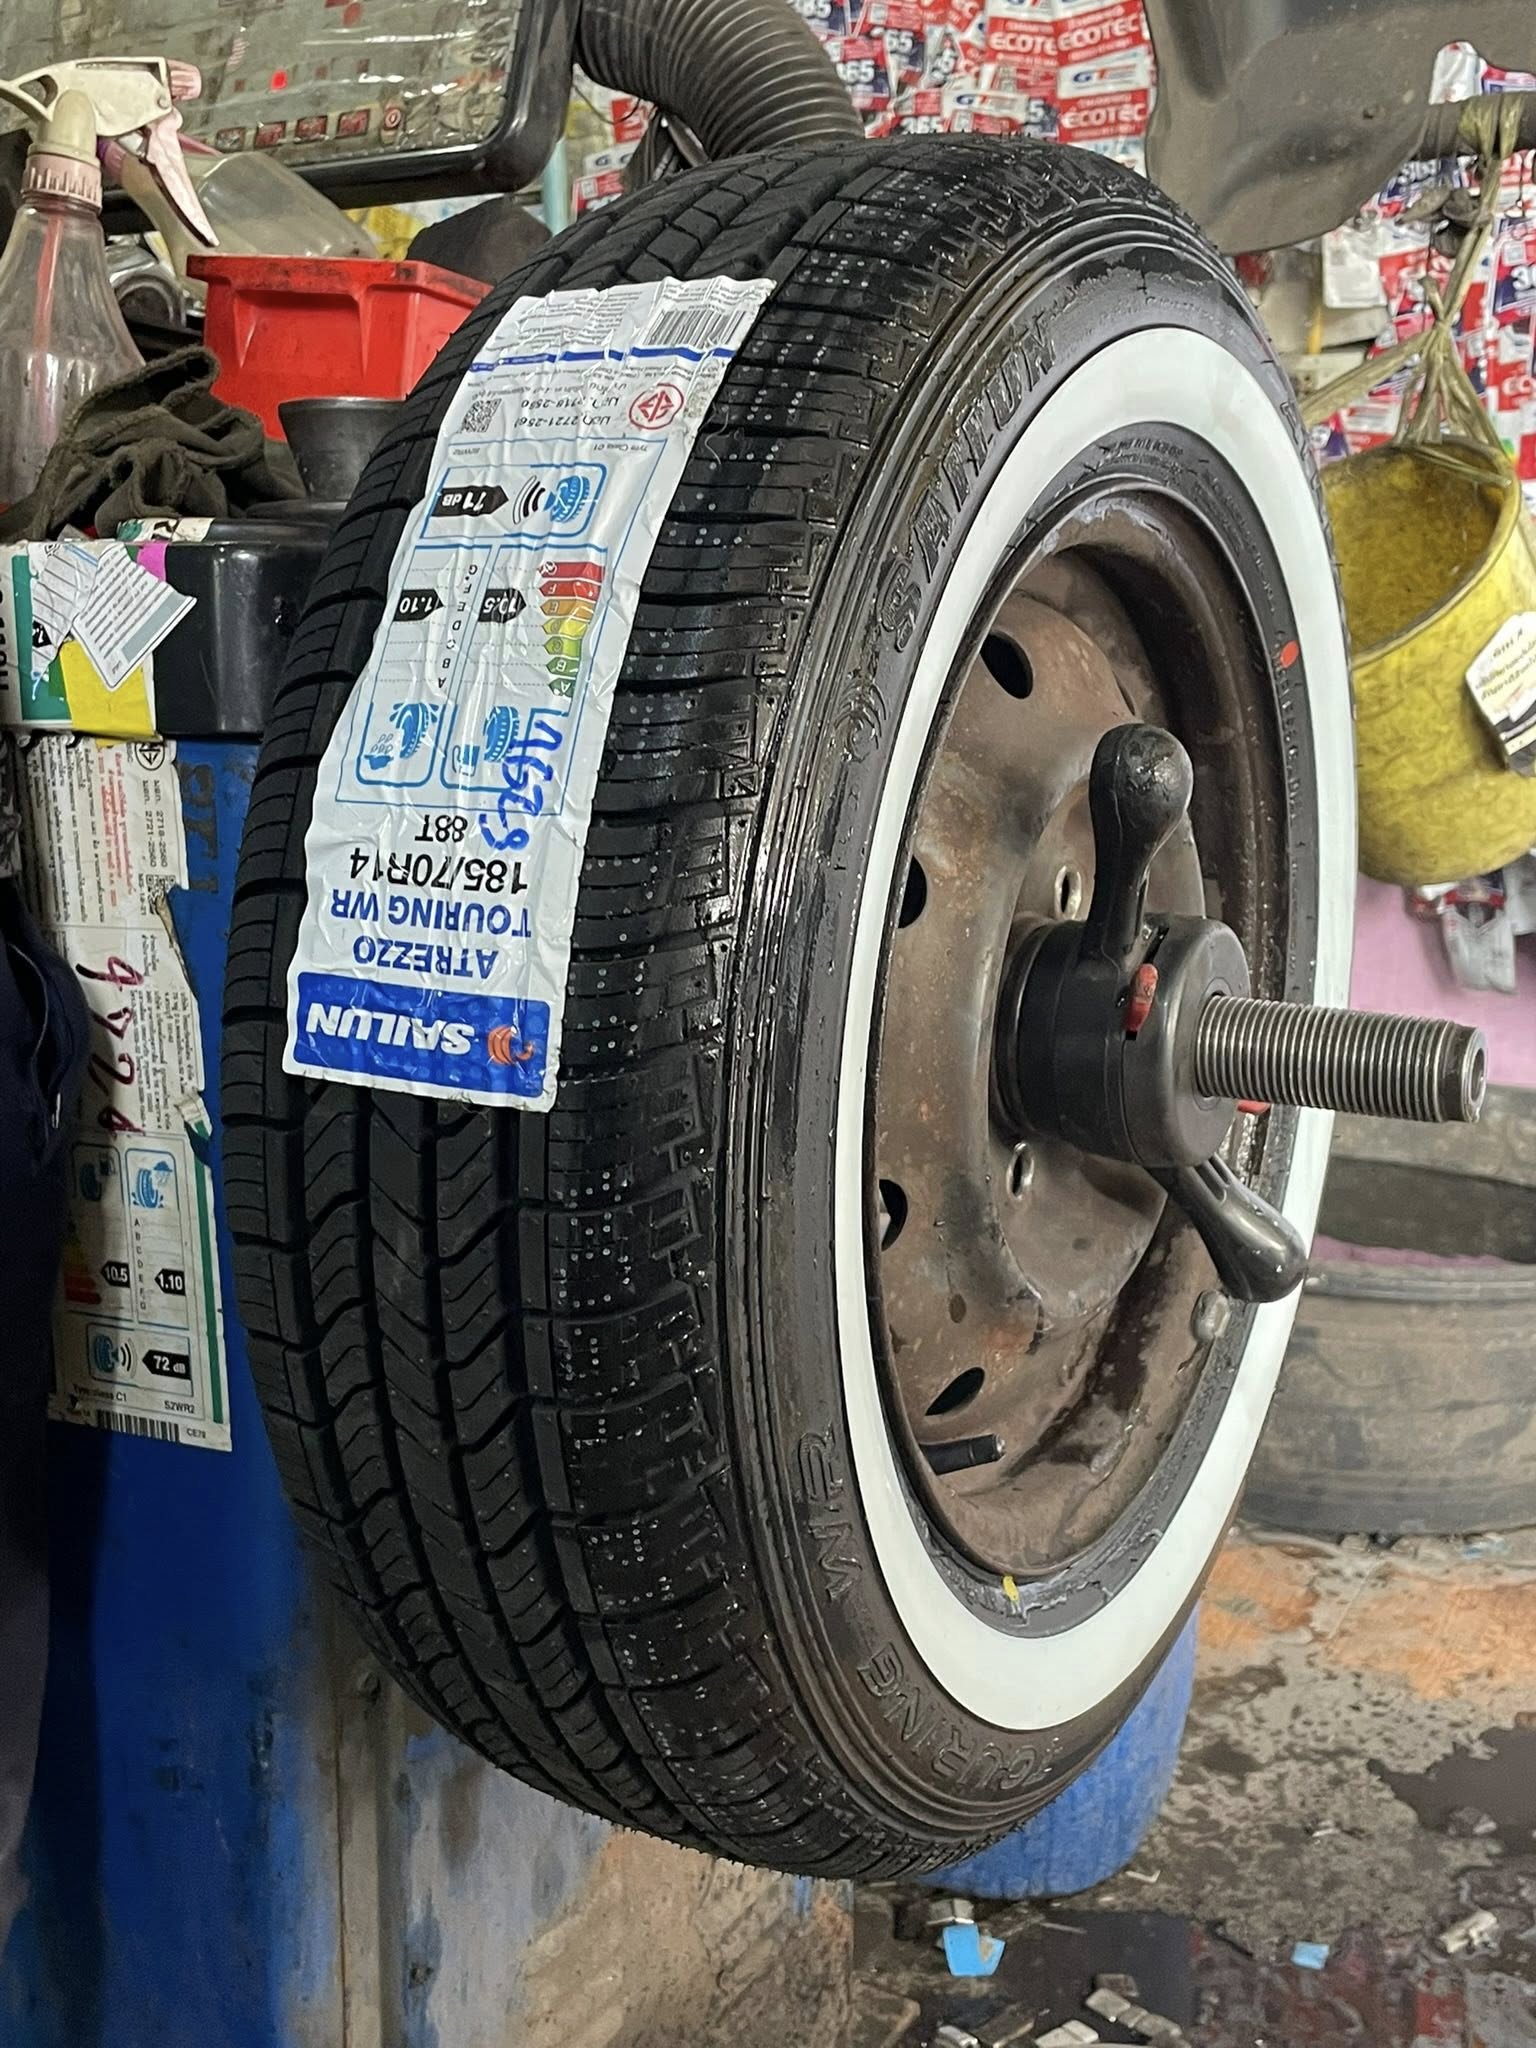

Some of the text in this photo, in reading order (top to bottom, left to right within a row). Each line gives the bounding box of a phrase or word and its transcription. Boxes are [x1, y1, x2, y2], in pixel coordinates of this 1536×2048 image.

[988, 31, 1058, 56] ECOTE
[877, 314, 1056, 653] SAILUN
[442, 492, 462, 506] dB
[463, 583, 472, 594] F
[399, 597, 434, 614] 1.10
[457, 601, 466, 612] E
[452, 620, 462, 631] D
[442, 657, 452, 669] B
[437, 676, 447, 688] A
[415, 813, 469, 842] 88T
[350, 847, 529, 894] 185/70R14
[331, 888, 531, 937] TOURING WR
[353, 935, 498, 980] ATREZZO
[305, 1002, 475, 1055] SAILUN
[104, 1265, 128, 1283] 10.5
[158, 1273, 183, 1291] 1.10
[153, 1355, 186, 1374] 72 dB
[116, 1391, 127, 1402] C1
